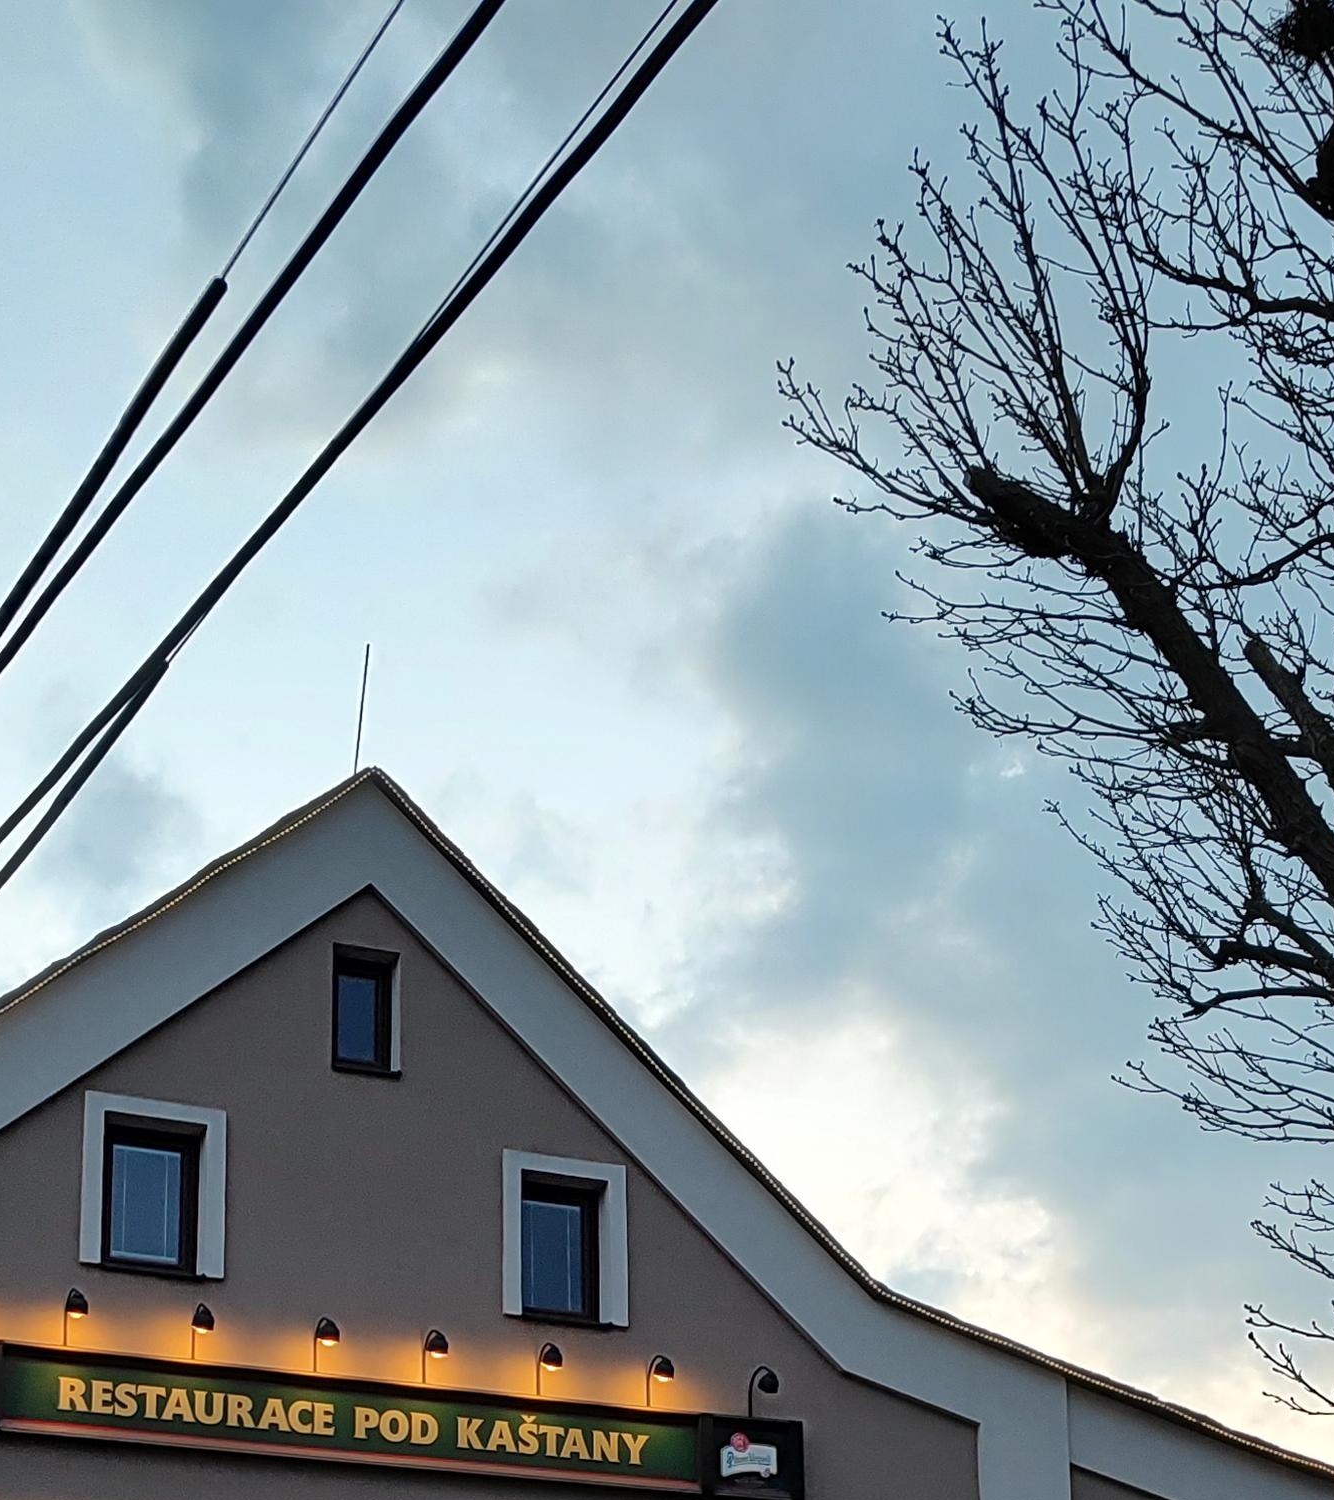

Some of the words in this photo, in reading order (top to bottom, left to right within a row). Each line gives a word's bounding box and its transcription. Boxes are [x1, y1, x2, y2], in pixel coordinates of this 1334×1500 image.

[57, 1376, 335, 1436] RESTAURACE
[353, 1406, 439, 1446] POD
[456, 1415, 650, 1465] KAŠTANY
